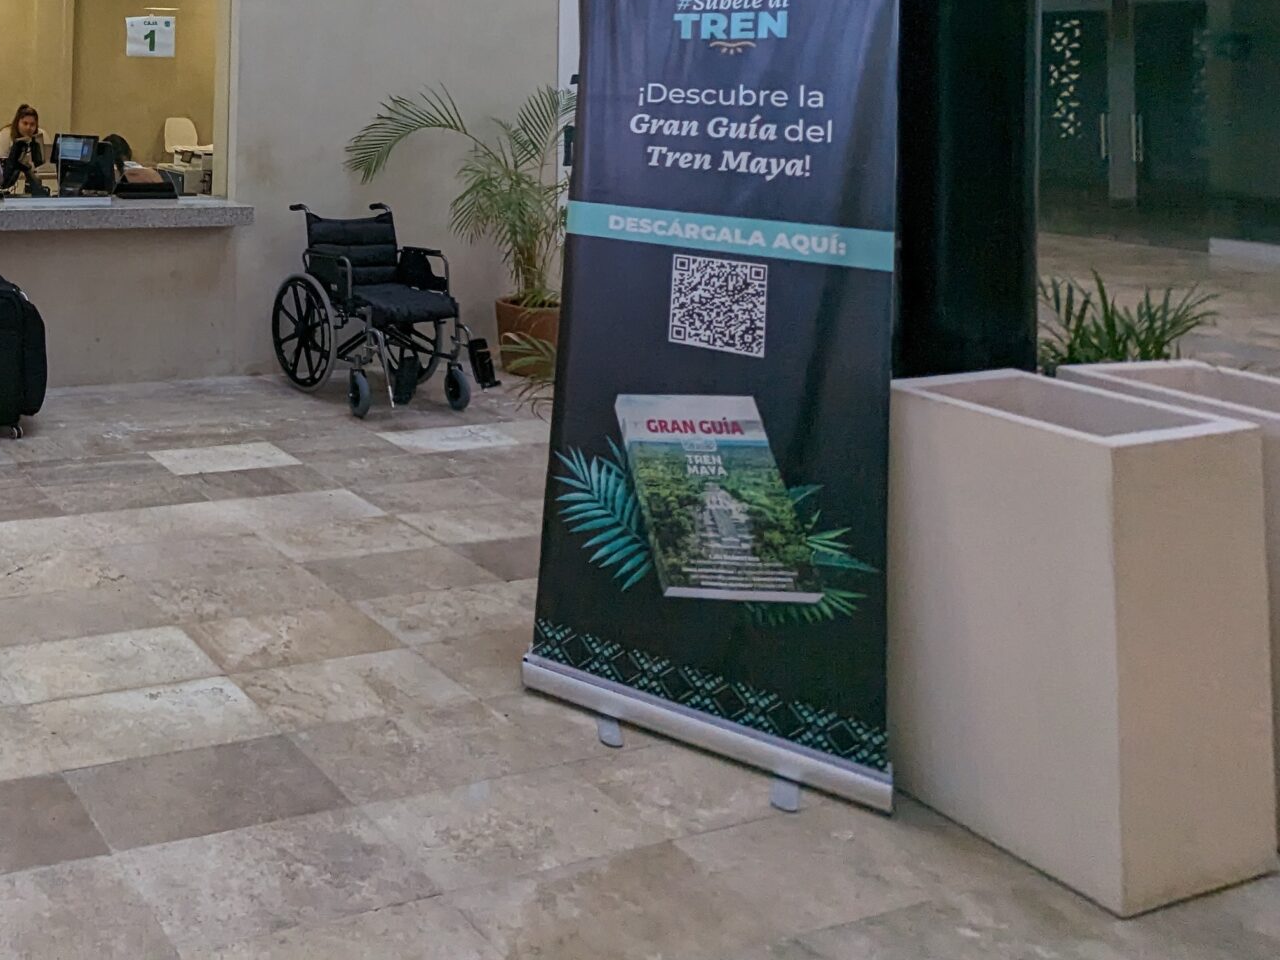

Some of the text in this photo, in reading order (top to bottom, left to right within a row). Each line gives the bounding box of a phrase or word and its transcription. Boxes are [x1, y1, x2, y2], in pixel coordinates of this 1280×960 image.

[673, 10, 788, 40] TREN
[144, 29, 156, 52] 1
[638, 82, 824, 108] ¡Descubre la
[629, 113, 833, 144] Gran Guía del
[646, 145, 812, 182] Tren Maya!
[607, 214, 847, 257] DESCÁRGALA AQUÍ:
[646, 416, 745, 436] GRAN GUÍA
[685, 454, 722, 465] TREN
[686, 465, 729, 476] MAYA
